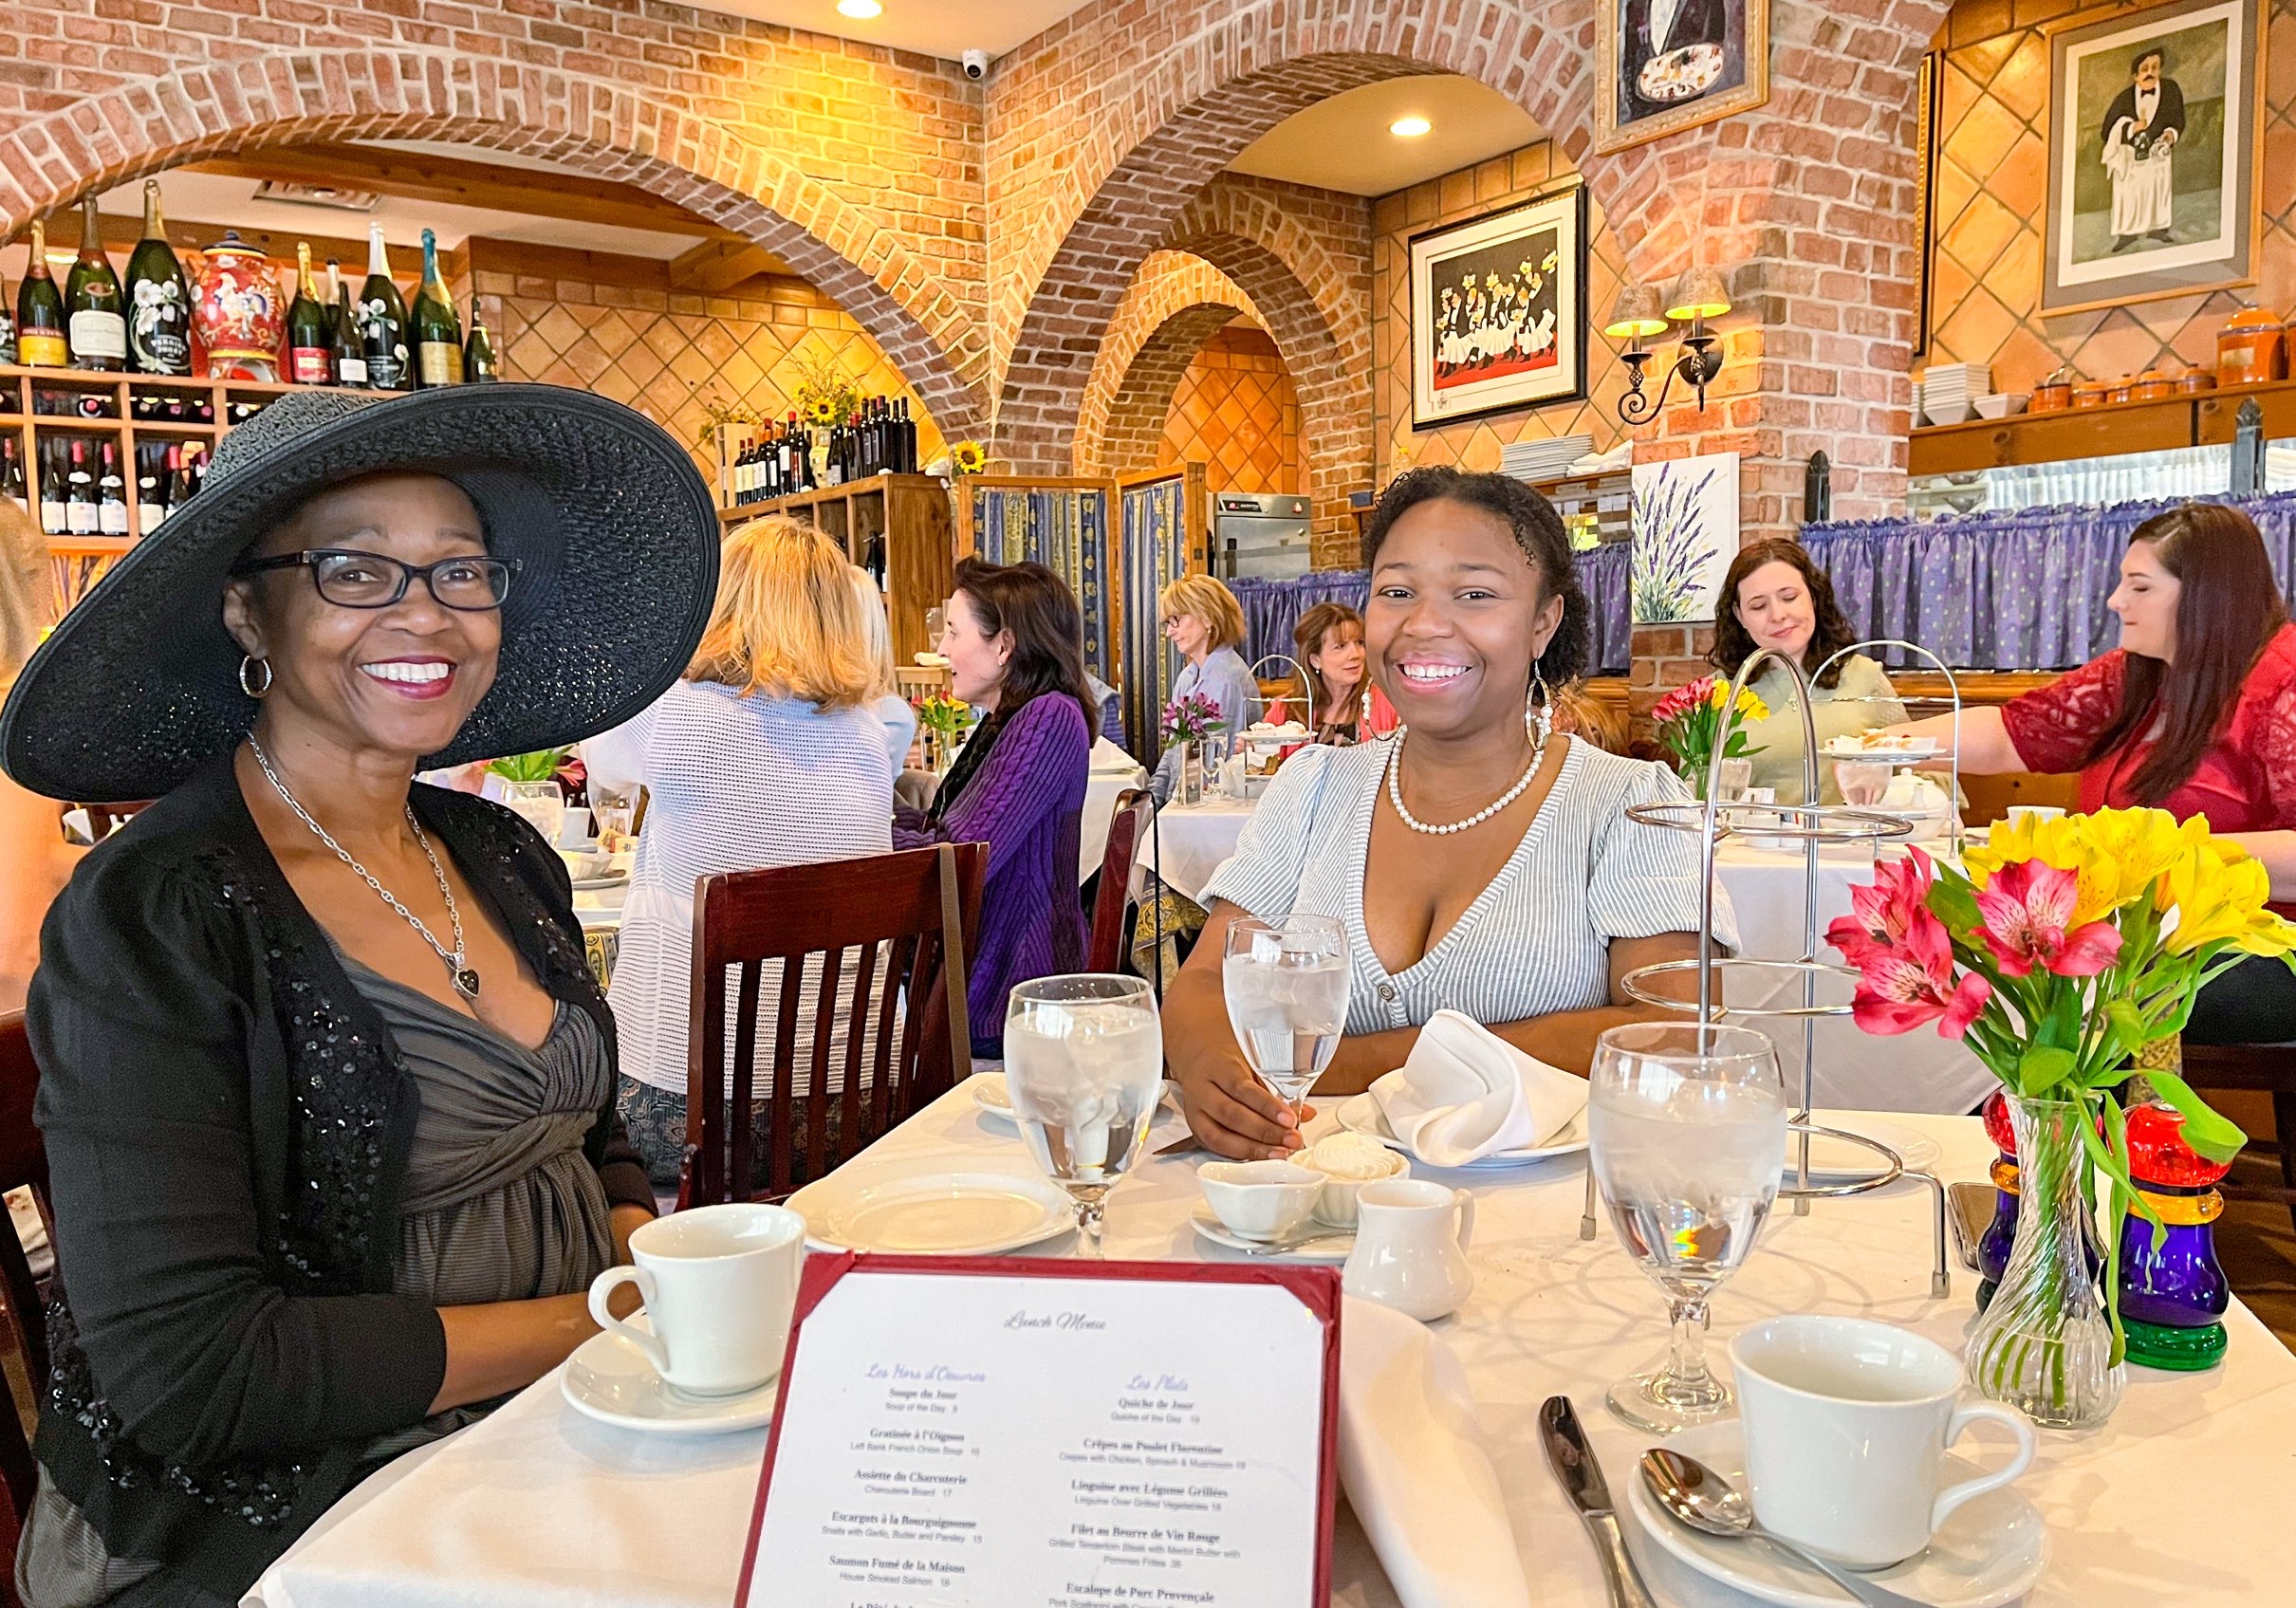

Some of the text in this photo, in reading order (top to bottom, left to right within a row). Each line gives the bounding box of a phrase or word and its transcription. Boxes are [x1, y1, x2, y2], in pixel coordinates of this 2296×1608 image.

[1004, 1309, 1107, 1330] Lunch Menu
[920, 1388, 933, 1399] du
[936, 1390, 957, 1400] Jour
[885, 1402, 905, 1412] Soup
[907, 1402, 916, 1411] of
[916, 1402, 929, 1412] the
[930, 1403, 946, 1414] Day
[1118, 1397, 1154, 1410] Quiche
[1171, 1399, 1194, 1410] Jour
[1140, 1413, 1150, 1421] of
[1151, 1413, 1164, 1422] the
[1166, 1414, 1182, 1424] Day
[870, 1427, 912, 1440] Gratinée
[915, 1430, 920, 1440] à
[850, 1441, 864, 1451] Left
[866, 1442, 886, 1451] Bank
[888, 1443, 916, 1453] French
[917, 1445, 940, 1454] Onion
[942, 1446, 963, 1456] Soup
[1120, 1441, 1133, 1450] au
[1137, 1440, 1168, 1452] Poulet
[1171, 1441, 1223, 1454] Florentine
[1090, 1452, 1106, 1463] with
[1108, 1453, 1142, 1466] Chicken,
[1145, 1455, 1178, 1466] Spinach
[1180, 1457, 1187, 1468] &
[854, 1469, 891, 1481] Assiette
[909, 1472, 968, 1486] Charcuterie
[911, 1487, 935, 1497] Board
[943, 1488, 953, 1498] 17
[1071, 1479, 1116, 1492] Linguine
[1119, 1483, 1139, 1493] avec
[1143, 1484, 1184, 1496] Légume
[1074, 1494, 1109, 1506] Linguine
[1112, 1496, 1132, 1506] Over
[1163, 1499, 1209, 1511] Vegetables
[832, 1511, 879, 1525] Escargots
[880, 1514, 887, 1525] à
[890, 1515, 898, 1525] la
[822, 1525, 845, 1536] Snails
[847, 1527, 863, 1537] with
[864, 1527, 890, 1540] Garlic,
[892, 1530, 916, 1540] Butter
[917, 1531, 934, 1542] and
[935, 1532, 965, 1544] Parsley
[1071, 1524, 1220, 1544] Filet au Beurre de Vin Rouge
[1048, 1539, 1075, 1548] Grilled
[1121, 1543, 1146, 1553] Steak
[1148, 1543, 1165, 1553] with
[1195, 1547, 1221, 1558] Butter
[1223, 1549, 1241, 1559] with
[828, 1556, 965, 1574] Saumon Fumé de la Maison
[1102, 1555, 1139, 1566] Pommes
[1142, 1557, 1166, 1568] Frites
[839, 1572, 865, 1581] House
[867, 1574, 900, 1584] Smoked
[901, 1576, 932, 1586] Salmon
[1066, 1582, 1214, 1603] Escalope de Porc Provençale
